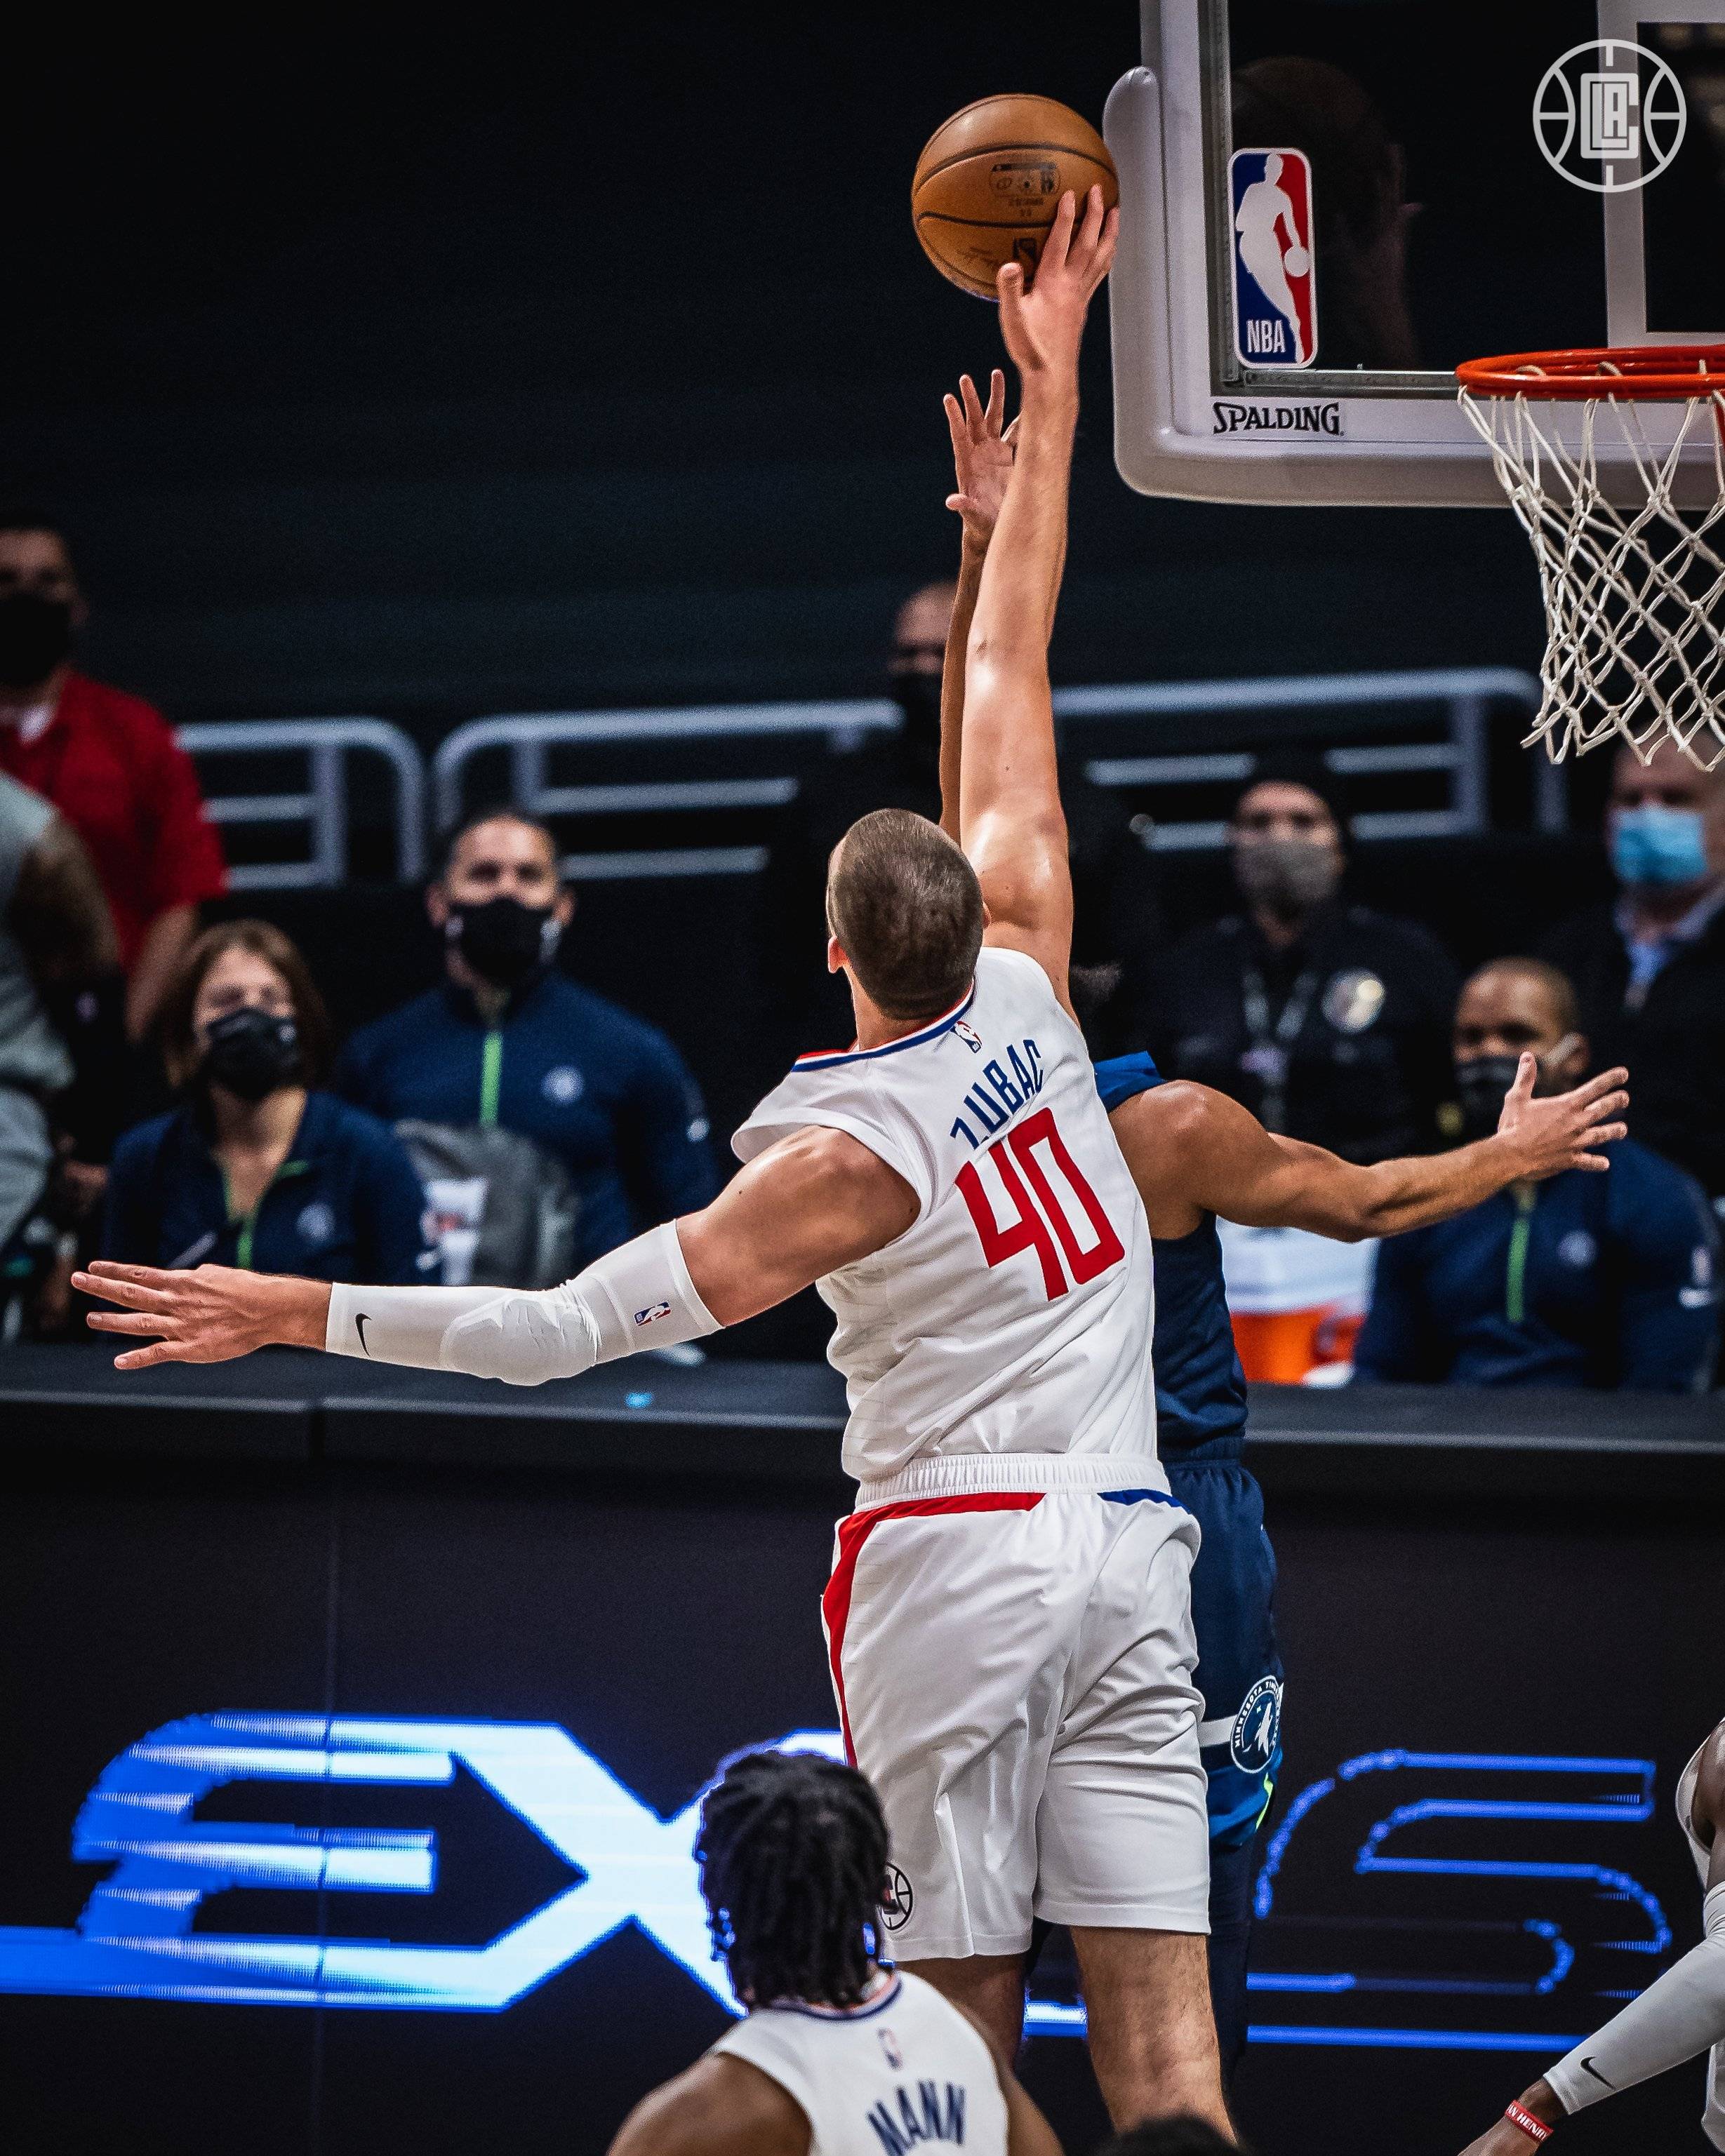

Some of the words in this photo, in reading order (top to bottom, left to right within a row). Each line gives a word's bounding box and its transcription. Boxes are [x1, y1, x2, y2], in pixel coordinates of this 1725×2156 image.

[1246, 319, 1286, 353] NBA
[1213, 401, 1340, 435] SPALDING
[950, 1039, 1044, 1151] ZUBAC
[954, 1106, 1126, 1301] 40
